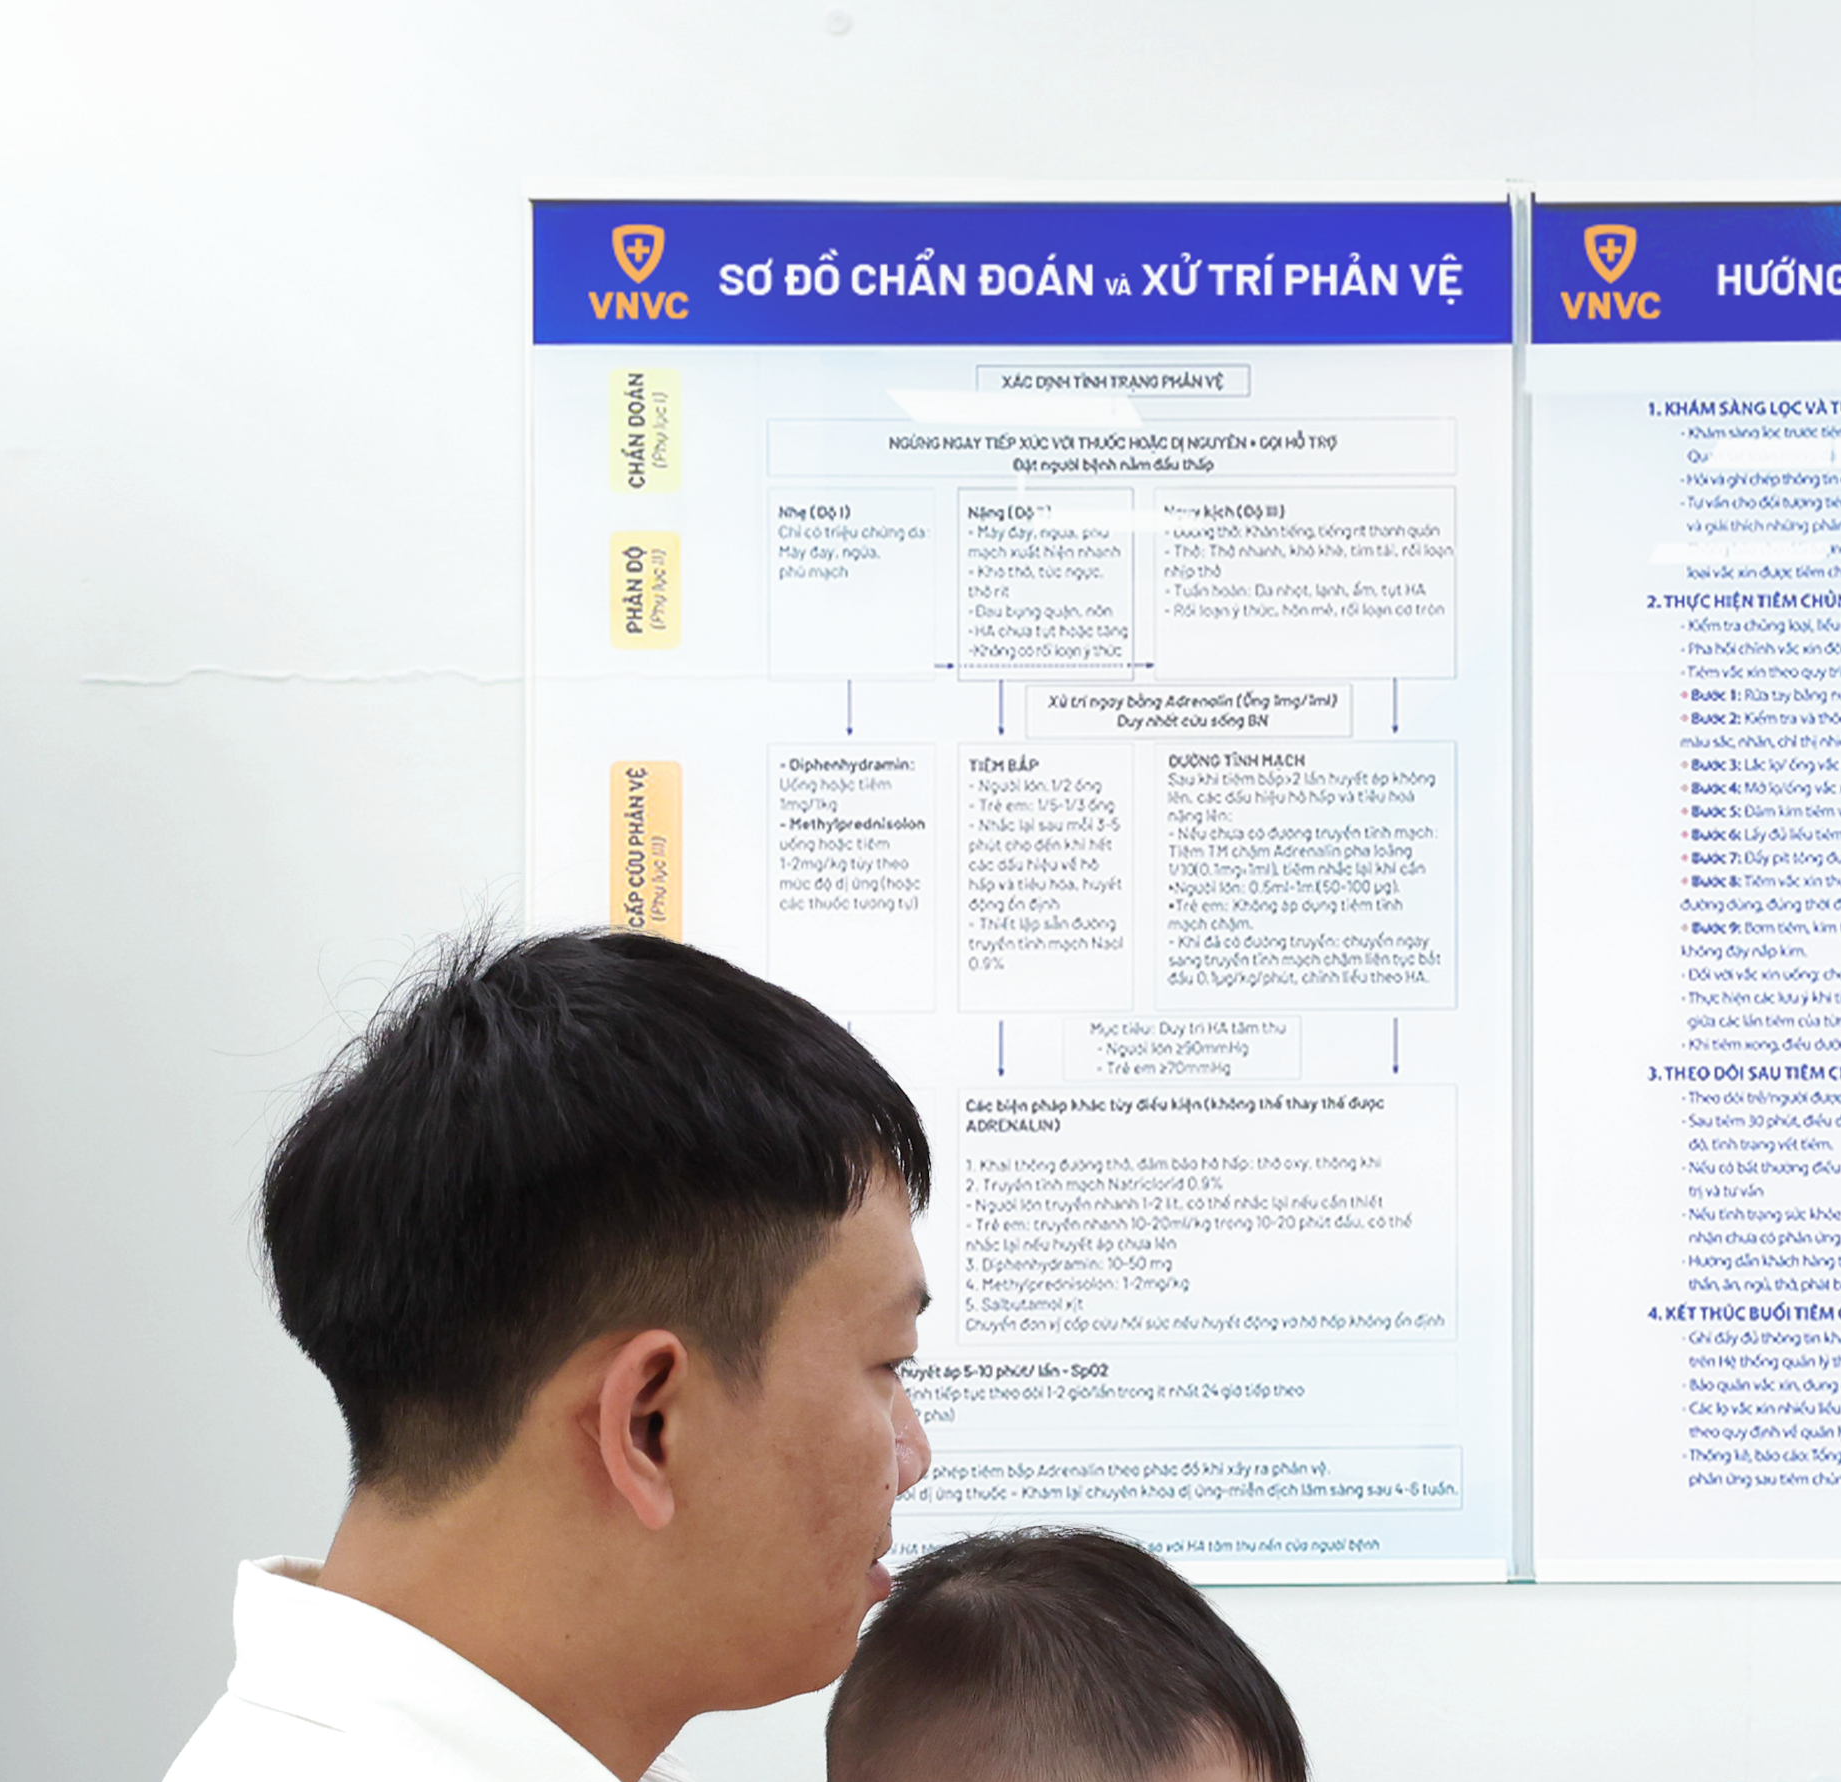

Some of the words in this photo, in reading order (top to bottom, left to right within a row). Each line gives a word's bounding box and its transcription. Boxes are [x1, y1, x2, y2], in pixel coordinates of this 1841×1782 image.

[717, 256, 775, 297] SƠ
[782, 247, 841, 297] ĐỒ
[850, 246, 967, 297] CHẨN
[976, 251, 1095, 297] ĐOÁN
[1103, 271, 1134, 297] VÀ
[1140, 250, 1204, 297] XỬ
[1206, 251, 1276, 297] TRÍ
[1283, 250, 1399, 297] PHẢN
[1408, 251, 1464, 307] VỆ
[586, 289, 690, 321] VNVC
[1558, 289, 1662, 321] VNVC
[1648, 401, 1662, 417] 1.
[1664, 398, 1716, 417] KHÁM
[1718, 398, 1767, 417] SÀNG
[1769, 400, 1802, 419] LỌC
[1804, 398, 1828, 415] VÀ
[1646, 594, 1662, 609] 2.
[1662, 592, 1711, 612] THỰC
[1713, 590, 1754, 612] HIỆN
[1756, 590, 1798, 609] TIÊM
[788, 757, 914, 775] Diphenhydramin:
[789, 816, 926, 835] Methylprednisolon
[1648, 1065, 1663, 1082] 3.
[1663, 1065, 1711, 1082] THEO
[1747, 1065, 1782, 1082] SAU
[1784, 1063, 1826, 1082] TIÊM
[1647, 1306, 1663, 1322] 4.
[1665, 1303, 1697, 1322] KẾT
[1699, 1303, 1746, 1322] THÚC
[1748, 1301, 1792, 1322] BUỔI
[1793, 1303, 1835, 1322] TIÊM
